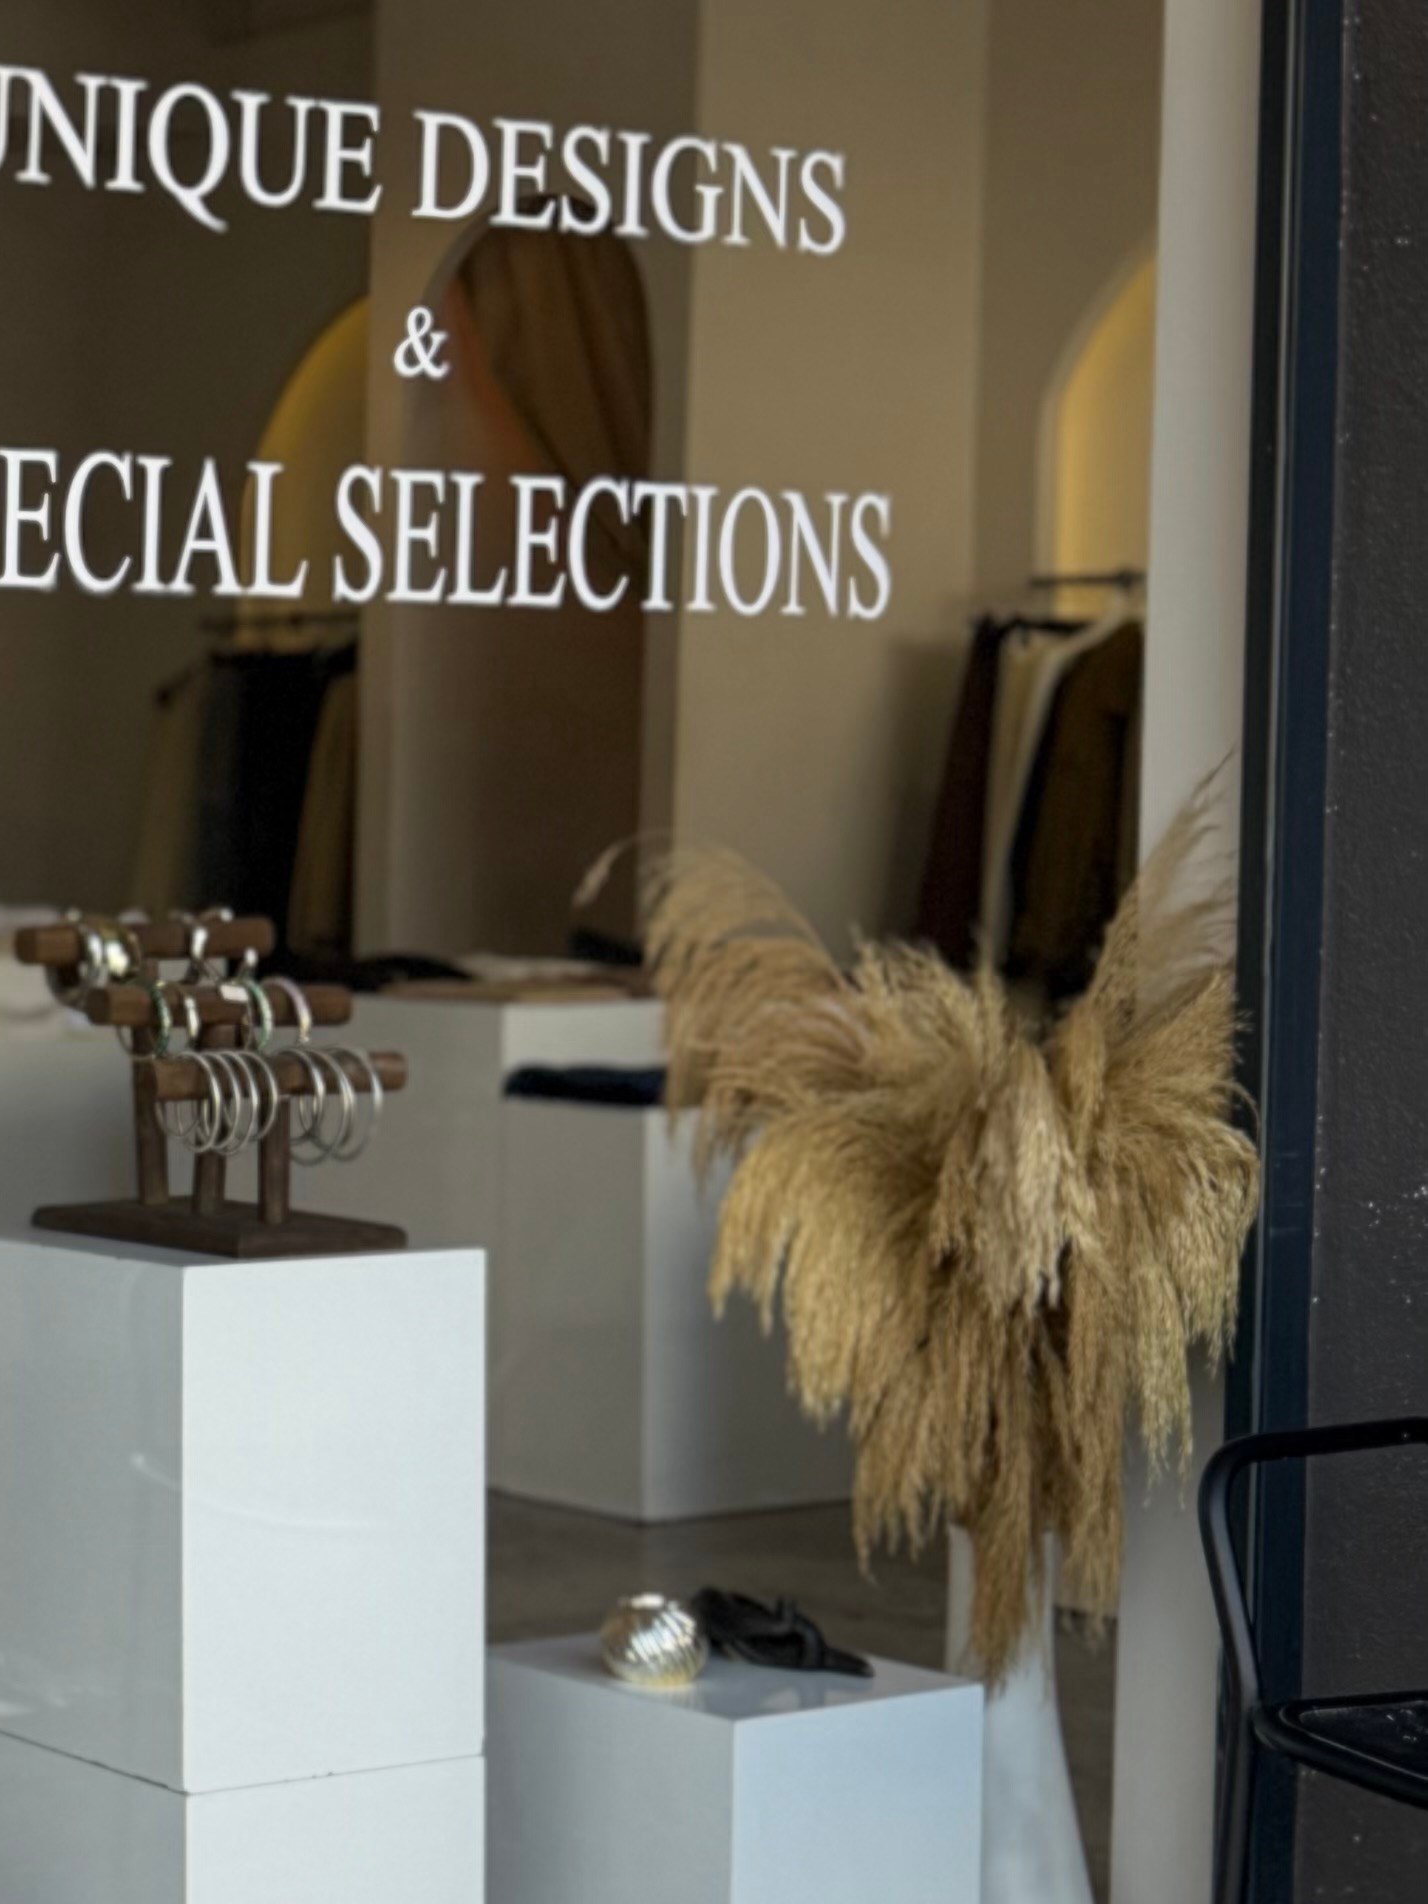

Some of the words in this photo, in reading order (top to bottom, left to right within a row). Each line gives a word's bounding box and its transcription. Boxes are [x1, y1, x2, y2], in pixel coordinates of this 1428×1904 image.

[410, 109, 847, 256] DESIGNS
[392, 304, 451, 380] &
[332, 462, 894, 623] SELECTIONS
